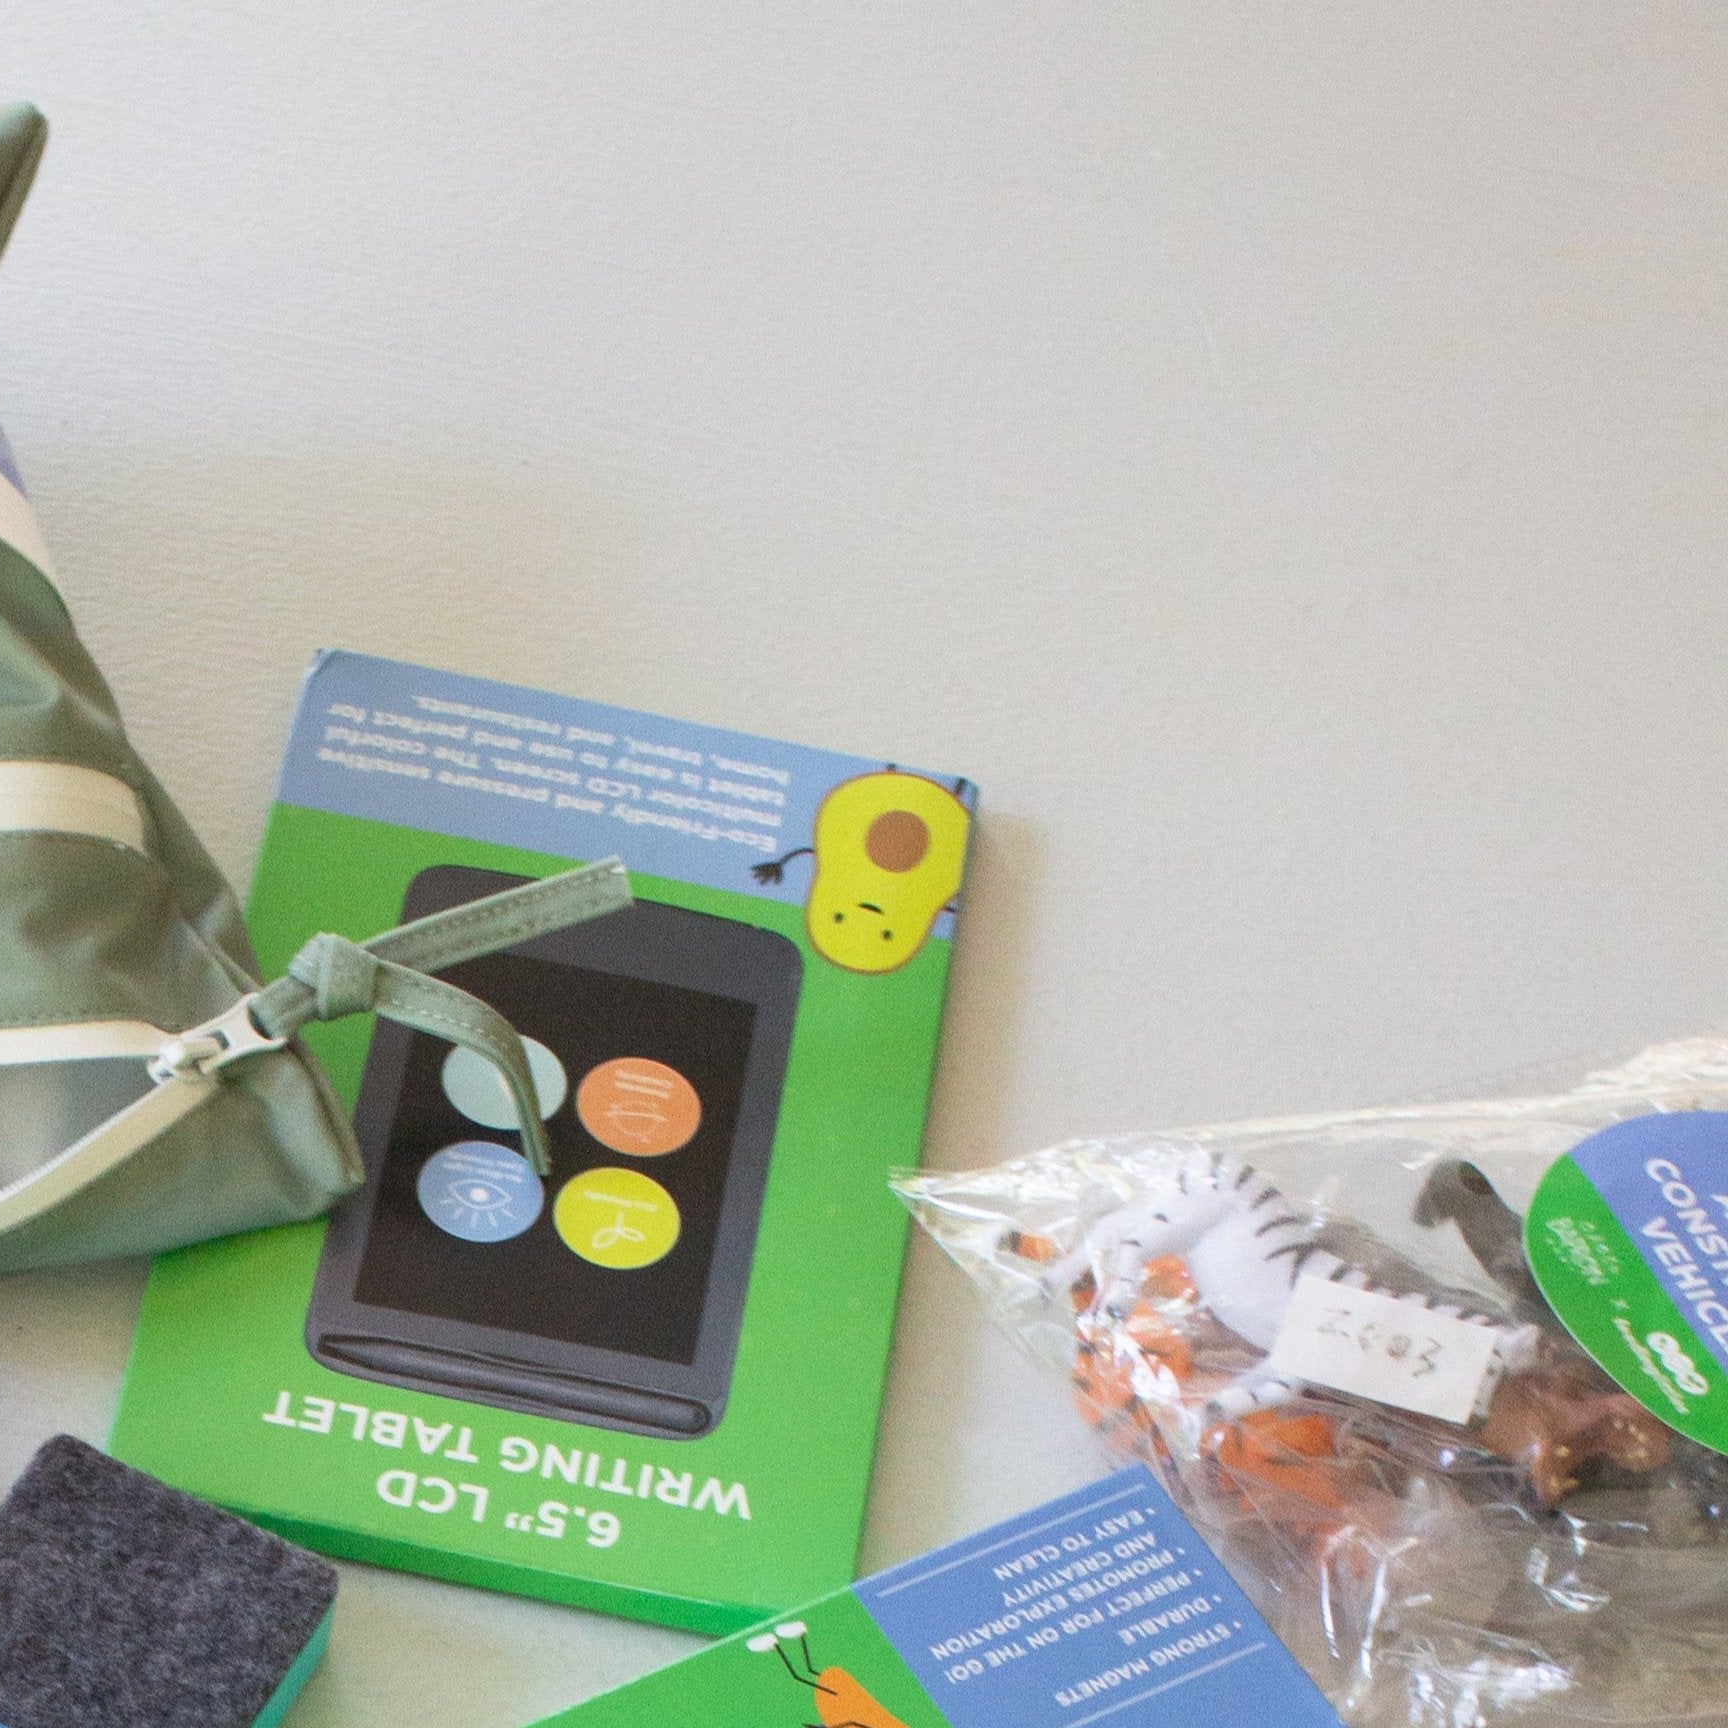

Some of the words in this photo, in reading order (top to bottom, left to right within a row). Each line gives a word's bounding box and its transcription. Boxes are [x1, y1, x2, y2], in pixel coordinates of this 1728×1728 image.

[328, 704, 366, 722] for
[372, 710, 467, 739] perfect
[324, 725, 426, 753] colorful
[472, 730, 522, 751] and
[566, 726, 614, 746] and
[318, 746, 430, 778] sensitive
[432, 746, 478, 768] The
[528, 742, 574, 760] use
[614, 757, 673, 780] easy
[437, 770, 550, 802] pressure
[587, 776, 641, 799] LCD
[707, 778, 784, 806] tablet
[555, 793, 604, 813] and
[646, 789, 781, 825] multicolor
[262, 1391, 478, 1462] TABLET
[497, 1435, 752, 1521] WRITING
[376, 1469, 489, 1522] LCD
[1093, 1508, 1145, 1540] EASY
[1061, 1532, 1092, 1553] TO
[1113, 1530, 1157, 1560] AND
[992, 1543, 1060, 1581] CLEAN
[1067, 1549, 1175, 1603] PROMOTES
[1001, 1551, 1114, 1607] CREATIVITY
[1106, 1570, 1191, 1618] PERFECT
[929, 1594, 1069, 1661] EXPLORATION
[1060, 1607, 1105, 1635] FOR
[1118, 1596, 1213, 1645] DURABLE
[1027, 1626, 1060, 1649] ON
[1149, 1622, 1231, 1667] STRONG
[983, 1642, 1026, 1668] THE
[943, 1658, 984, 1684] GO!
[1054, 1657, 1150, 1707] MAGNETS
